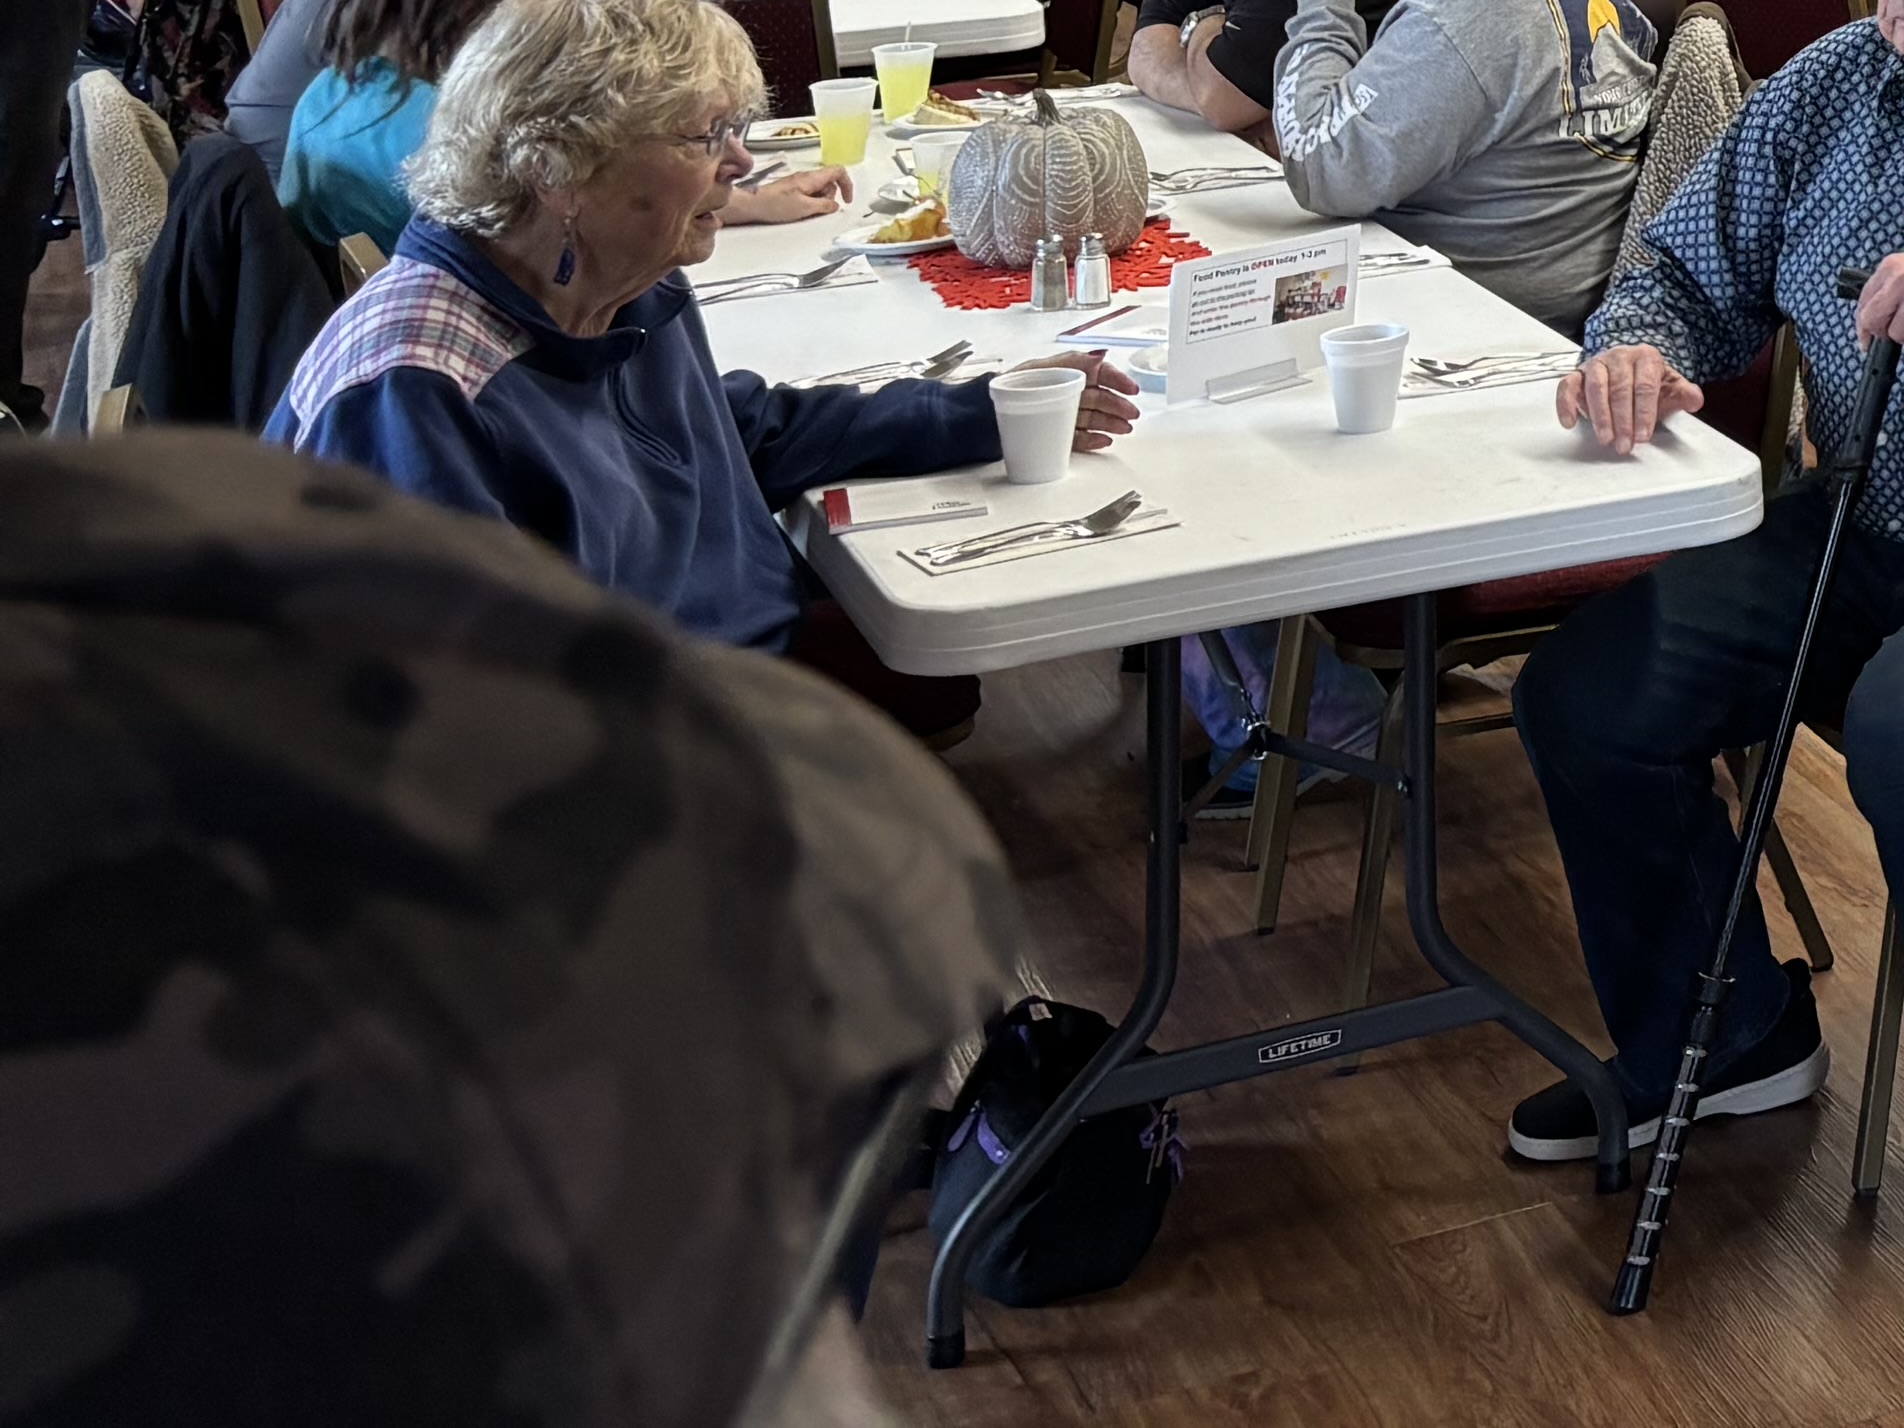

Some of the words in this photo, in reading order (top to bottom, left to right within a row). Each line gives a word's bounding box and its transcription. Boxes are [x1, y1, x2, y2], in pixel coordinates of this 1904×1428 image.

[1250, 258, 1274, 271] OPEN
[1275, 253, 1297, 266] today
[1268, 1034, 1331, 1059] LIFETIME
